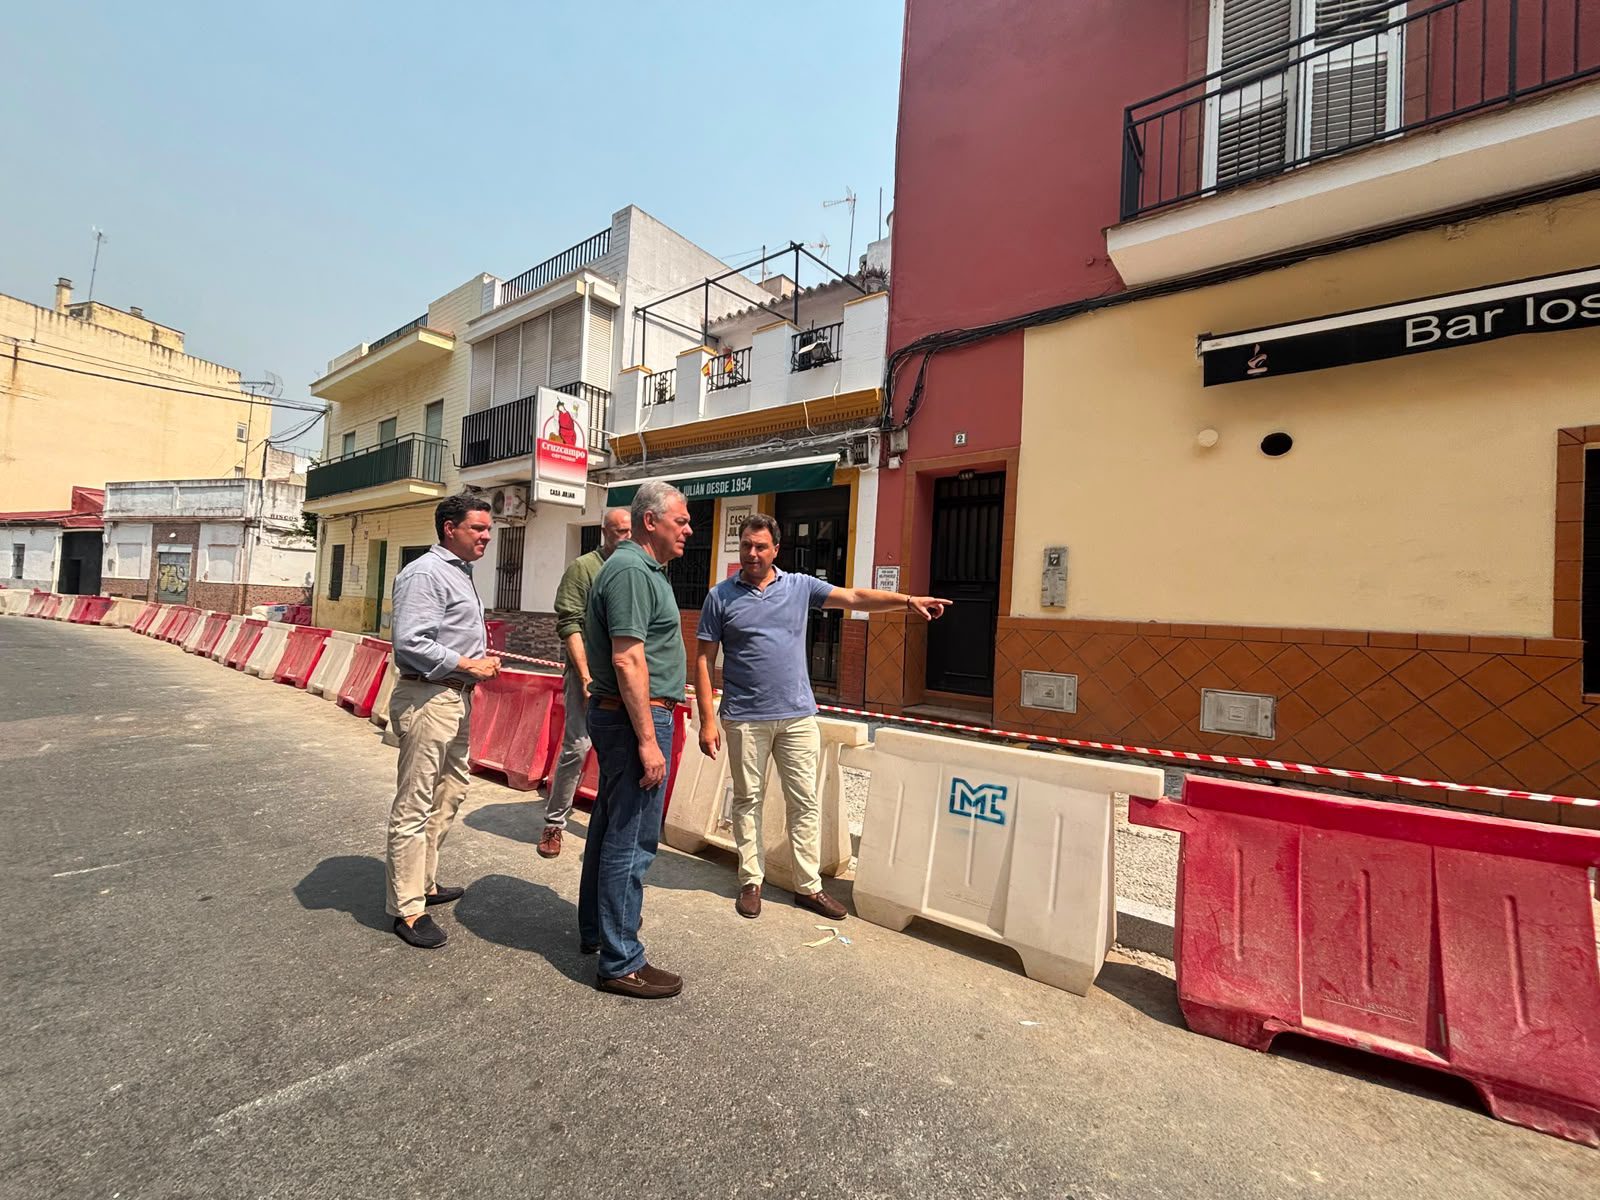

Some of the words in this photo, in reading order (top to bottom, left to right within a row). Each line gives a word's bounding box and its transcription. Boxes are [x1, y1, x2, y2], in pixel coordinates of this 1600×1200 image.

[1405, 308, 1504, 348] Bar
[1525, 293, 1600, 326] los
[541, 441, 586, 460] Cruzcampo
[549, 488, 561, 496] CASA
[706, 480, 730, 495] DESDE
[731, 477, 752, 493] 1954
[727, 526, 739, 537] JUL
